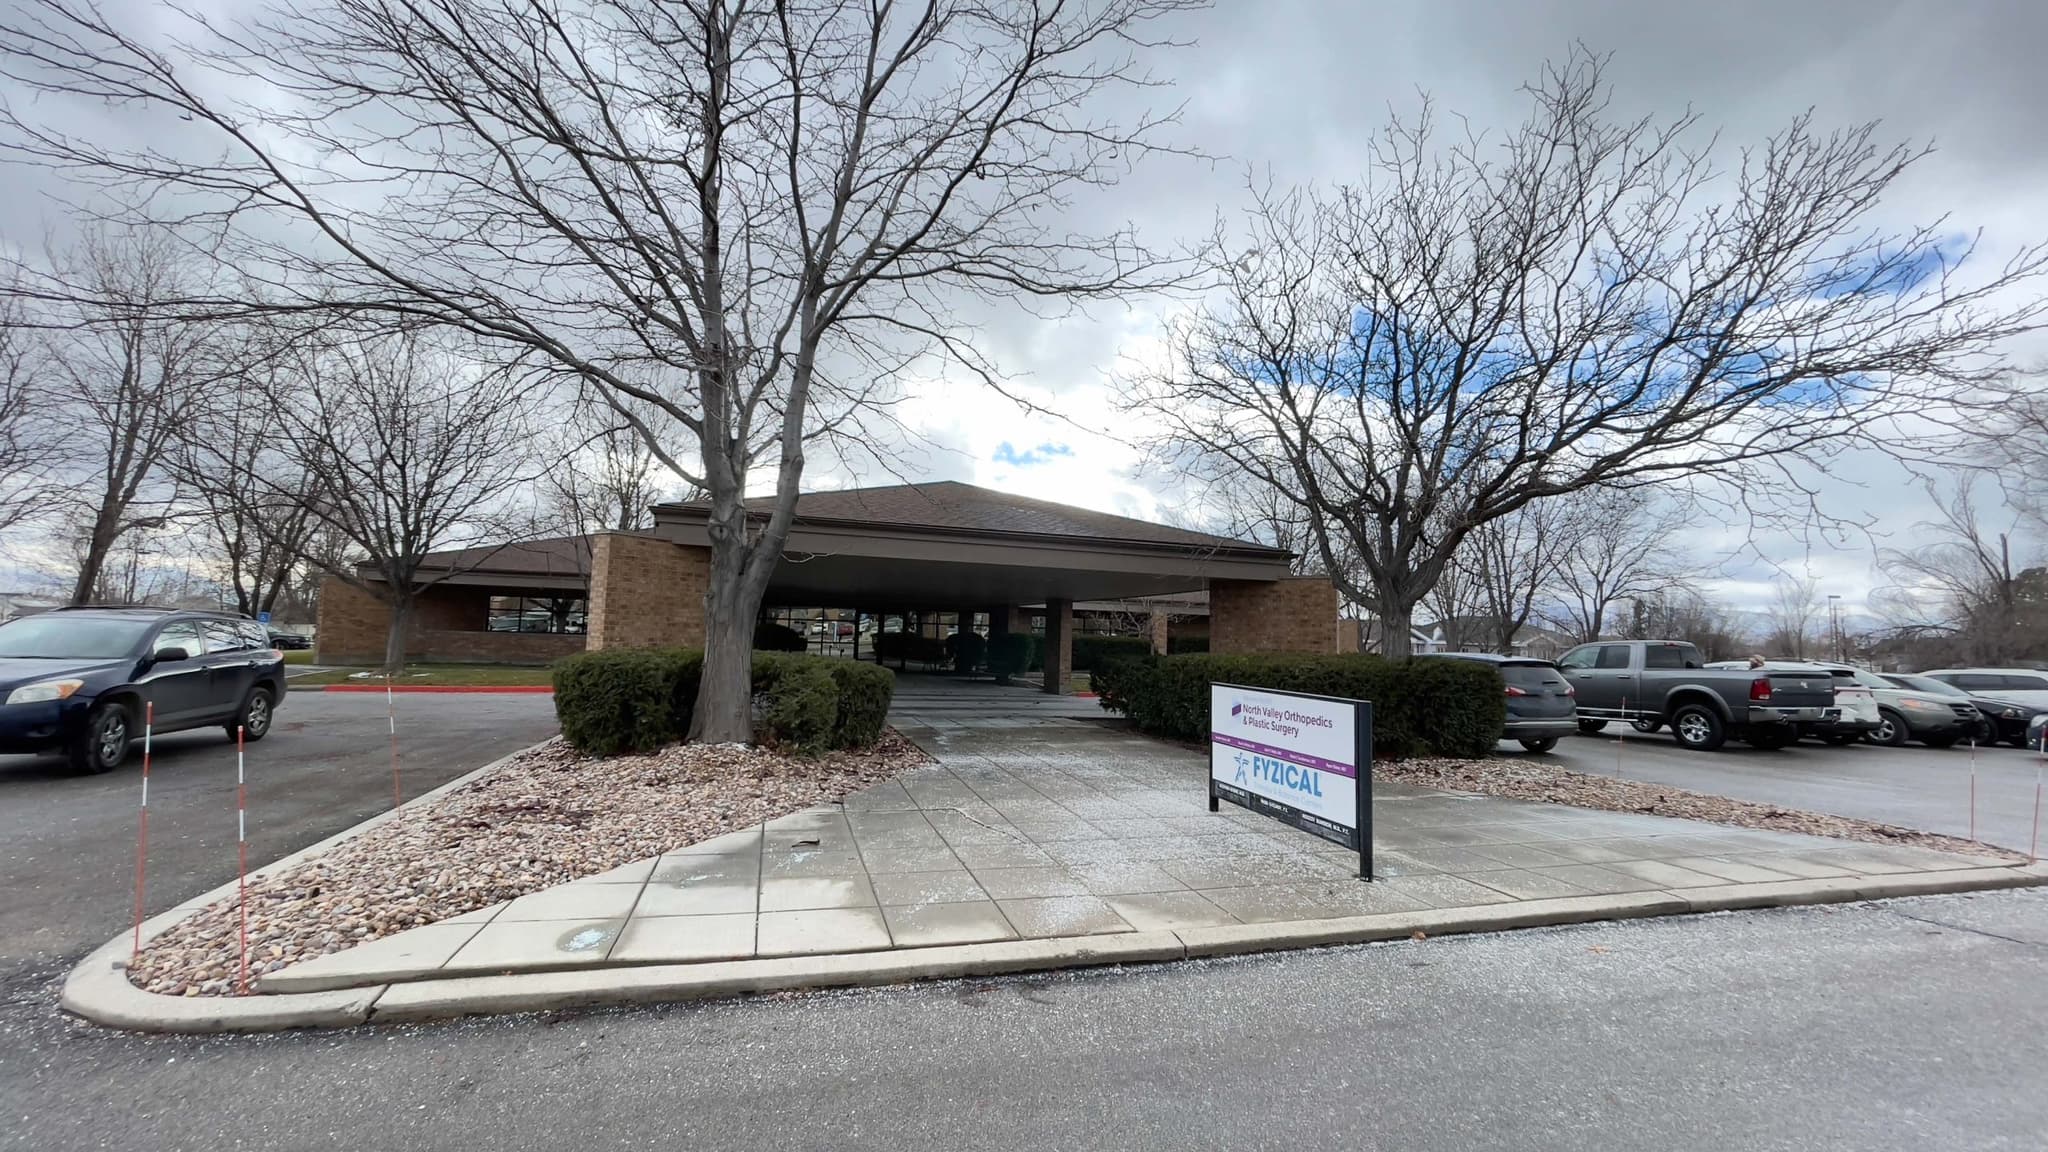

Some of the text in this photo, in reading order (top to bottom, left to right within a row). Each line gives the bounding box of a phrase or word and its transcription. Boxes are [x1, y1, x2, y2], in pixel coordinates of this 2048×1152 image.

[1243, 703, 1333, 729] North Valley Orthopedics
[1243, 715, 1299, 738] & Plastic Surgery
[1253, 755, 1322, 798] FYZICAL
